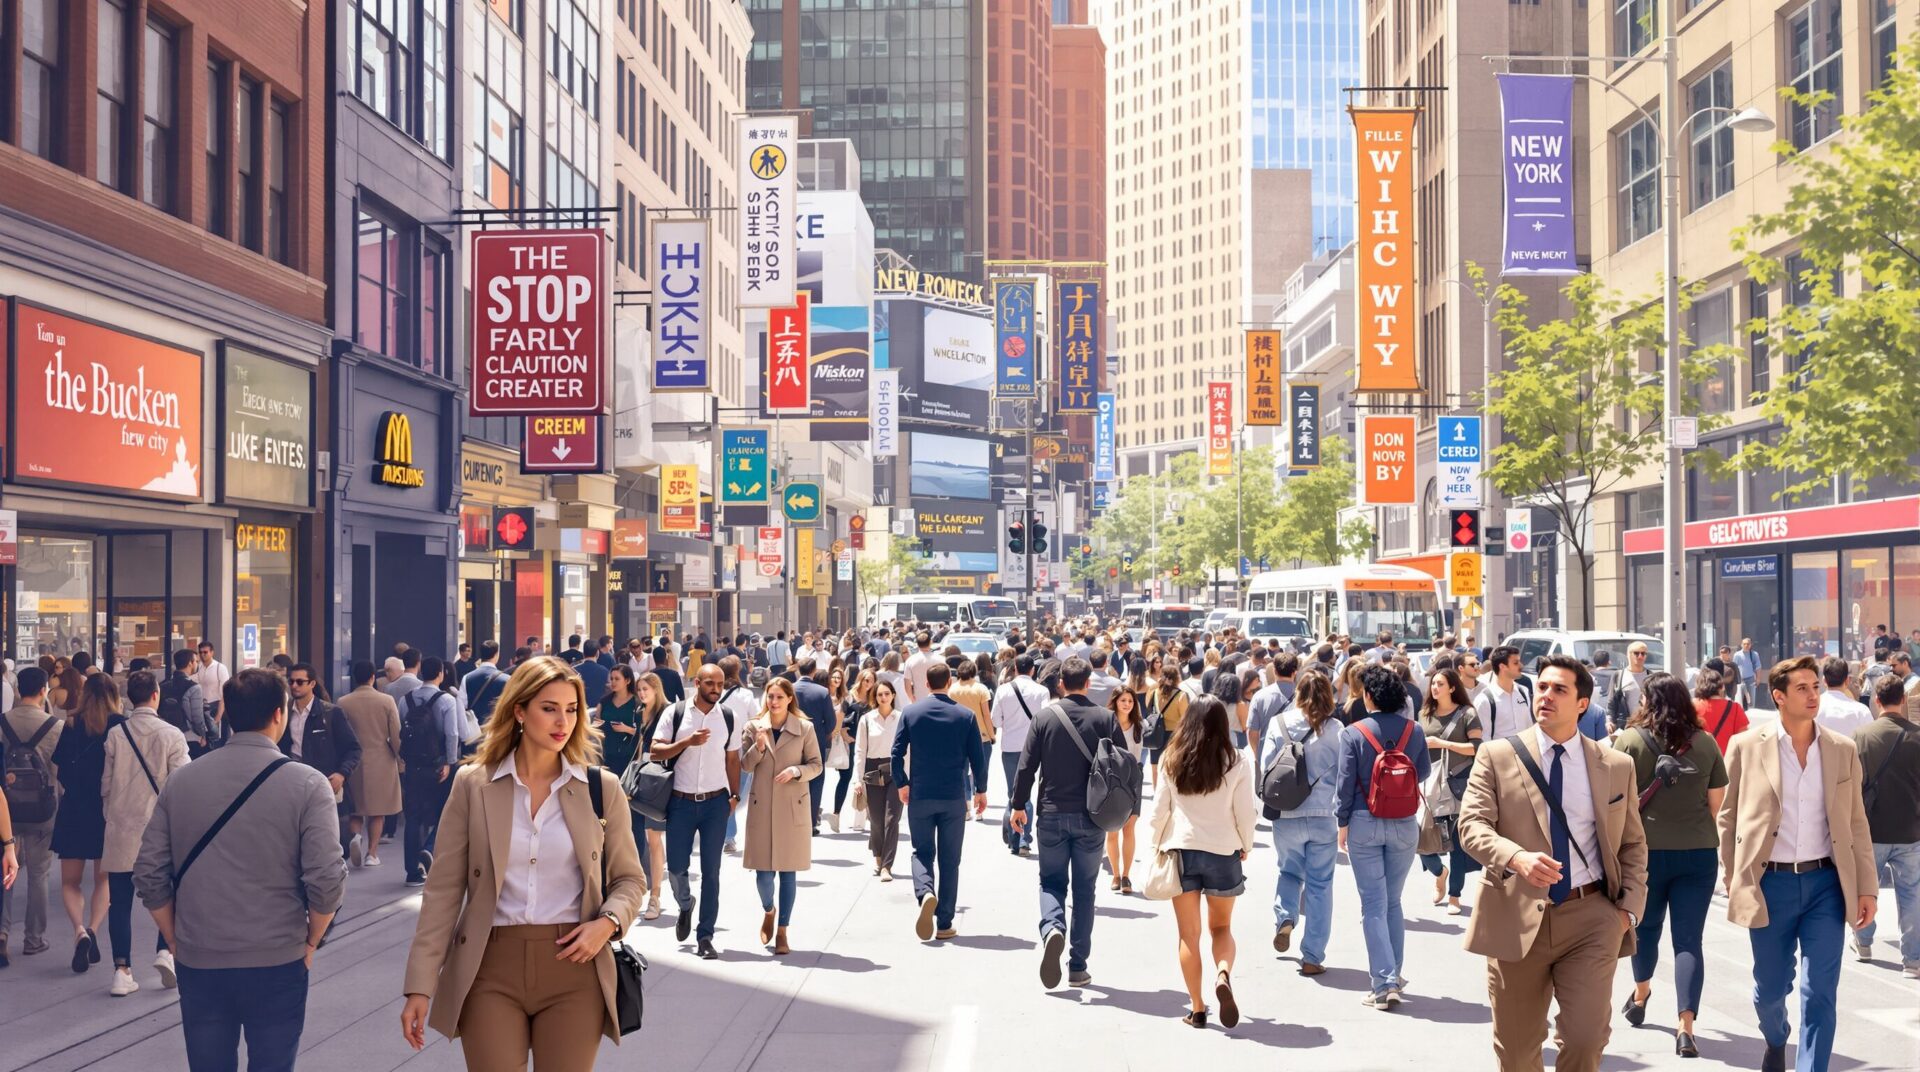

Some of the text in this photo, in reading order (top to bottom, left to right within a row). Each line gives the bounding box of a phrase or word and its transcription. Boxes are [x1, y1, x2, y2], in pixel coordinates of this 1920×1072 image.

[1365, 130, 1403, 142] FILLE
[1511, 135, 1563, 158] NEW
[1513, 163, 1563, 184] YORK
[509, 246, 568, 270] THE
[878, 269, 920, 293] NEW
[487, 275, 592, 323] STOP
[489, 327, 583, 352] FARLY
[485, 355, 588, 375] CLAUTION
[814, 364, 866, 379] Niskon
[45, 349, 181, 429] the Bucken
[485, 379, 584, 399] CREATER
[534, 418, 586, 436] CREEM
[1374, 432, 1404, 447] DON
[1372, 450, 1406, 462] NOVR
[1439, 446, 1478, 458] CERED
[1376, 465, 1403, 481] BY
